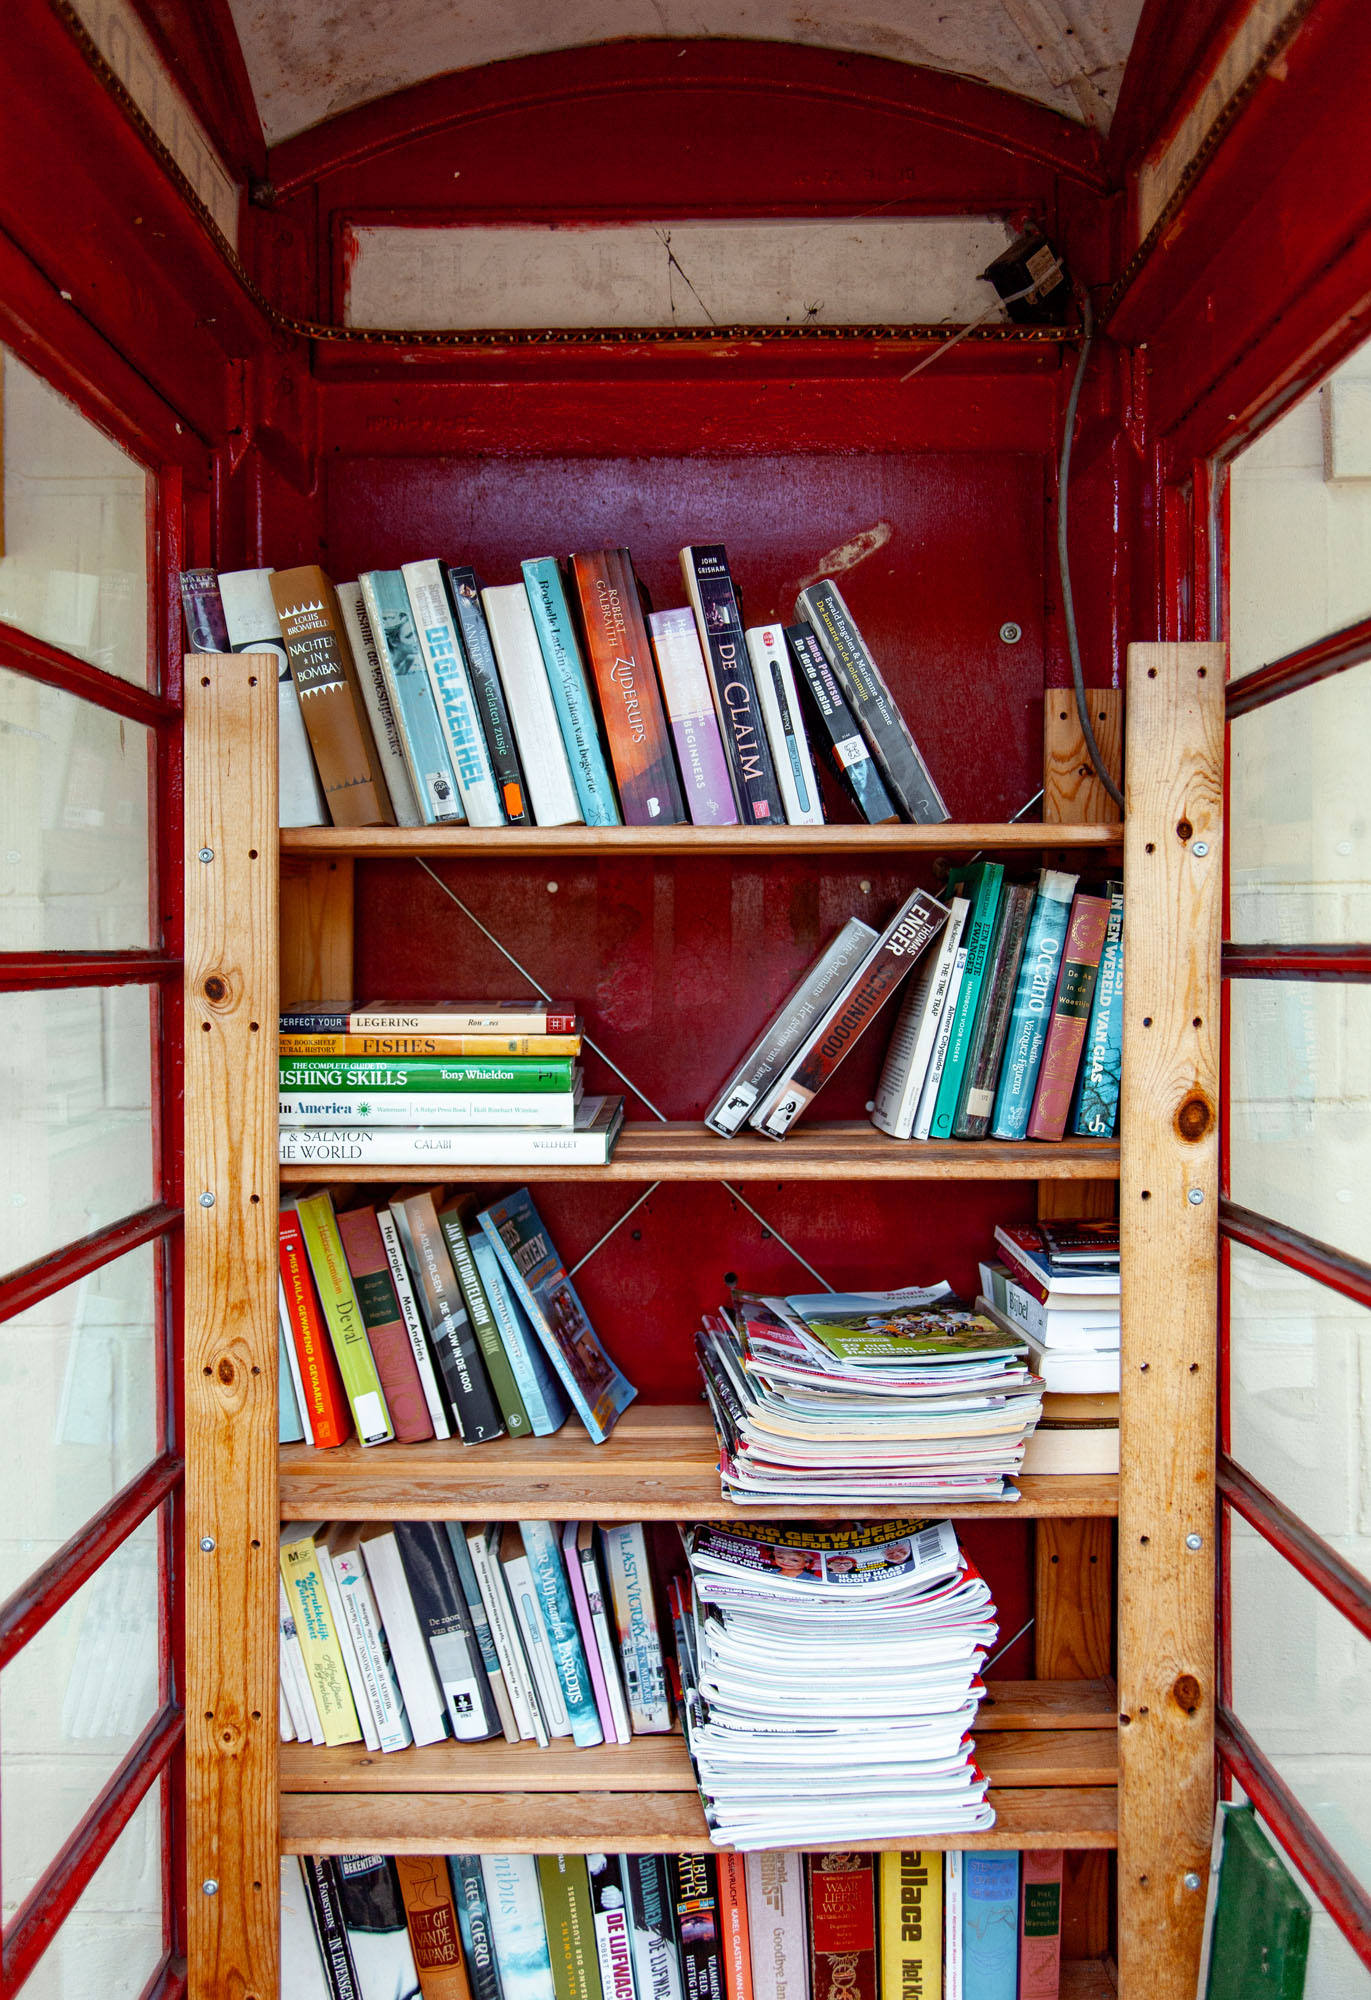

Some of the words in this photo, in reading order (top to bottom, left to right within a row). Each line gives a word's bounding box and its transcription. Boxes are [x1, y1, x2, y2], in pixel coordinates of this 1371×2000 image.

[182, 574, 213, 584] MAREK
[698, 565, 726, 574] GRISHAM
[182, 582, 216, 591] HALTER
[539, 580, 558, 626] Rochelle
[596, 580, 618, 647] GALBRAITH
[608, 589, 626, 633] ROBERT
[287, 619, 328, 636] BROMFIELD
[294, 613, 319, 624] LOUIS
[289, 637, 336, 657] NACHTEN
[310, 652, 323, 664] IN
[464, 622, 484, 675] ANDREWS
[551, 630, 565, 667] Larkin
[719, 643, 737, 670] DE
[816, 600, 823, 611] De
[822, 611, 840, 643] kanarie
[836, 641, 844, 651] in
[841, 649, 849, 662] de
[846, 660, 869, 702] kolenmijn
[297, 661, 341, 683] BOMBAY
[805, 635, 824, 662] James
[818, 662, 843, 707] Patterson
[825, 597, 841, 622] Ewald
[837, 619, 855, 652] Engelen
[856, 659, 877, 697] Marianne
[874, 692, 893, 727] Thieme
[795, 639, 803, 653] De
[801, 651, 818, 679] derde
[812, 678, 833, 716] aanslag
[560, 671, 580, 725] Vruchten
[611, 656, 646, 743] ZIJDERUPS
[484, 678, 500, 725] Verlaten
[494, 728, 509, 756] zusje
[574, 727, 585, 747] van
[724, 682, 764, 782] CLAIM
[682, 721, 706, 789] BEGINNERS
[579, 748, 596, 794] begeerte
[1112, 893, 1123, 910] IN
[885, 903, 930, 956] ENGER
[906, 924, 935, 956] THOMAS
[948, 919, 962, 953] Mackenzie
[983, 922, 991, 939] EEN
[1107, 914, 1121, 943] EEN
[965, 921, 982, 975] ZWANGER
[974, 940, 987, 977] BEETJE
[812, 952, 848, 998] Oerlemans
[1028, 938, 1059, 1012] Océano
[1068, 970, 1078, 978] De
[1100, 945, 1117, 1007] WERELD
[938, 979, 947, 997] TIME
[961, 981, 973, 1018] HANDBOEK
[798, 1002, 816, 1021] Het
[821, 963, 895, 1059] SCHIJNDOOD
[932, 1000, 940, 1017] TRAP
[1059, 996, 1090, 1008] Woestijn
[318, 1018, 342, 1027] YOUR
[356, 1018, 419, 1027] LEGERING
[777, 1016, 801, 1049] geheim
[943, 1006, 955, 1033] Almere
[957, 1018, 967, 1037] VOOR
[1096, 1010, 1110, 1043] VAN
[363, 1039, 435, 1053] FISHES
[766, 1045, 779, 1063] van
[935, 1035, 950, 1072] Cityguide
[952, 1039, 962, 1063] VADERS
[1012, 1020, 1035, 1095] Vázquez-Figueroa
[1029, 1032, 1042, 1064] Alberto
[308, 1062, 349, 1070] COMPLETE
[350, 1062, 375, 1070] GUIDE
[376, 1062, 387, 1070] TO
[751, 1063, 773, 1085] Paros
[1091, 1045, 1106, 1083] GLAS
[346, 1070, 407, 1086] SKILLS
[440, 1070, 464, 1081] Tony
[465, 1070, 514, 1080] Whieldon
[295, 1102, 351, 1114] America
[289, 1132, 298, 1142] &
[303, 1132, 374, 1142] SALMON
[533, 1141, 578, 1149] WELLFLEET
[300, 1145, 362, 1159] WORLD
[384, 1226, 394, 1244] Het
[445, 1223, 460, 1241] JAN
[289, 1253, 299, 1274] MISS
[387, 1247, 405, 1282] project
[420, 1233, 444, 1294] ADLER-OLSEN
[292, 1275, 304, 1304] LAILA,
[452, 1241, 490, 1326] VANTOORTELBOOM
[336, 1300, 354, 1323] De
[402, 1296, 414, 1322] Marc
[440, 1301, 450, 1315] DE
[490, 1278, 510, 1325] JONATHAN
[1008, 1290, 1029, 1321] Bijbel
[298, 1304, 314, 1355] GEWAPEND
[344, 1324, 363, 1345] val
[444, 1315, 460, 1347] VROUW
[480, 1327, 500, 1356] MAUK
[410, 1324, 426, 1363] Andries
[452, 1346, 461, 1358] IN
[455, 1358, 466, 1372] DE
[309, 1364, 325, 1415] GEVAARLIJK
[459, 1371, 474, 1393] KOOI
[755, 1533, 777, 1543] DE
[780, 1538, 830, 1549] LIEFDE
[833, 1541, 849, 1549] IS
[854, 1537, 871, 1547] TE
[540, 1565, 557, 1598] MIJ
[873, 1564, 907, 1575] HAAST
[295, 1579, 317, 1641] Fahrenheit
[305, 1571, 329, 1641] Verrukkelijk
[429, 1617, 439, 1626] De
[441, 1613, 460, 1624] zoon
[546, 1597, 561, 1622] naar
[626, 1582, 648, 1645] VICTORY
[432, 1627, 446, 1636] van
[448, 1623, 462, 1633] een
[551, 1618, 568, 1641] het
[557, 1639, 583, 1704] PARADIJS
[640, 1665, 652, 1705] MURARI
[368, 1681, 377, 1697] AVEC
[372, 1698, 385, 1725] MARIAGE
[343, 1856, 383, 1875] BEKENTENIS
[824, 1892, 863, 1903] LIEFDE
[826, 1882, 859, 1893] WAAR
[319, 1882, 335, 1928] FAIRSTEIN
[328, 1937, 342, 1951] IN
[411, 1914, 430, 1929] HET
[432, 1909, 450, 1928] GIF
[567, 1885, 583, 1946] FLUSSKREBSE
[606, 1912, 623, 1933] DE
[729, 1908, 740, 1935] KAREL
[417, 1943, 459, 1964] PAPAVER
[561, 1921, 573, 1961] OWENS
[600, 1938, 610, 1969] ROBERT
[648, 1937, 665, 1955] DE
[733, 1935, 744, 1972] GLASTRA
[773, 1927, 788, 1978] Goodbye
[575, 1947, 584, 1966] DER
[566, 1965, 577, 1996] DELIA
[686, 1955, 698, 1988] HEFTIG
[698, 1969, 708, 1995] VELD.
[736, 1972, 744, 1989] VAN
[902, 1959, 923, 1983] Het
